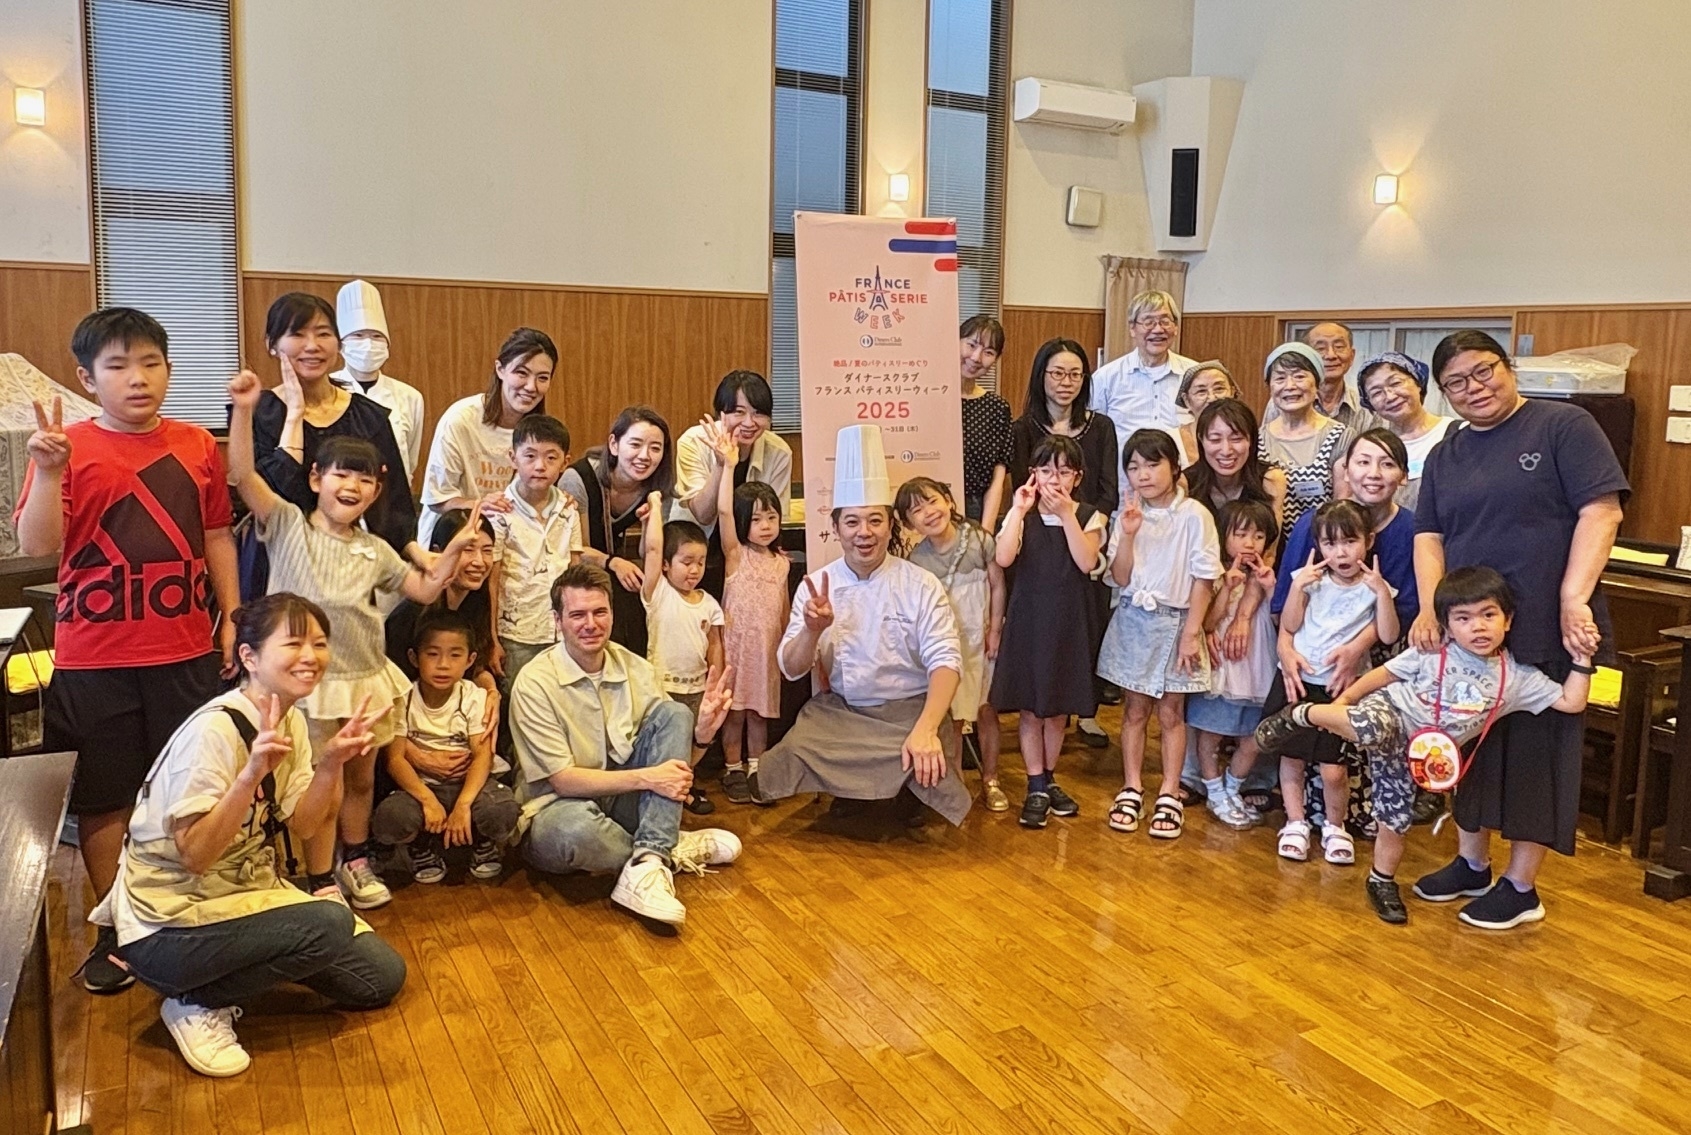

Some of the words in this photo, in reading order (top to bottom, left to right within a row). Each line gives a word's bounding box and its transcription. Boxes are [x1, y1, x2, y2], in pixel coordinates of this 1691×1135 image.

[855, 278, 911, 290] FRANCE
[854, 307, 905, 329] WEEK
[845, 372, 919, 383] ダイナースクラブ
[815, 386, 852, 396] フランス
[856, 385, 949, 396] パティスリーウィーク
[857, 402, 910, 419] 2025
[1462, 667, 1493, 690] SPACE
